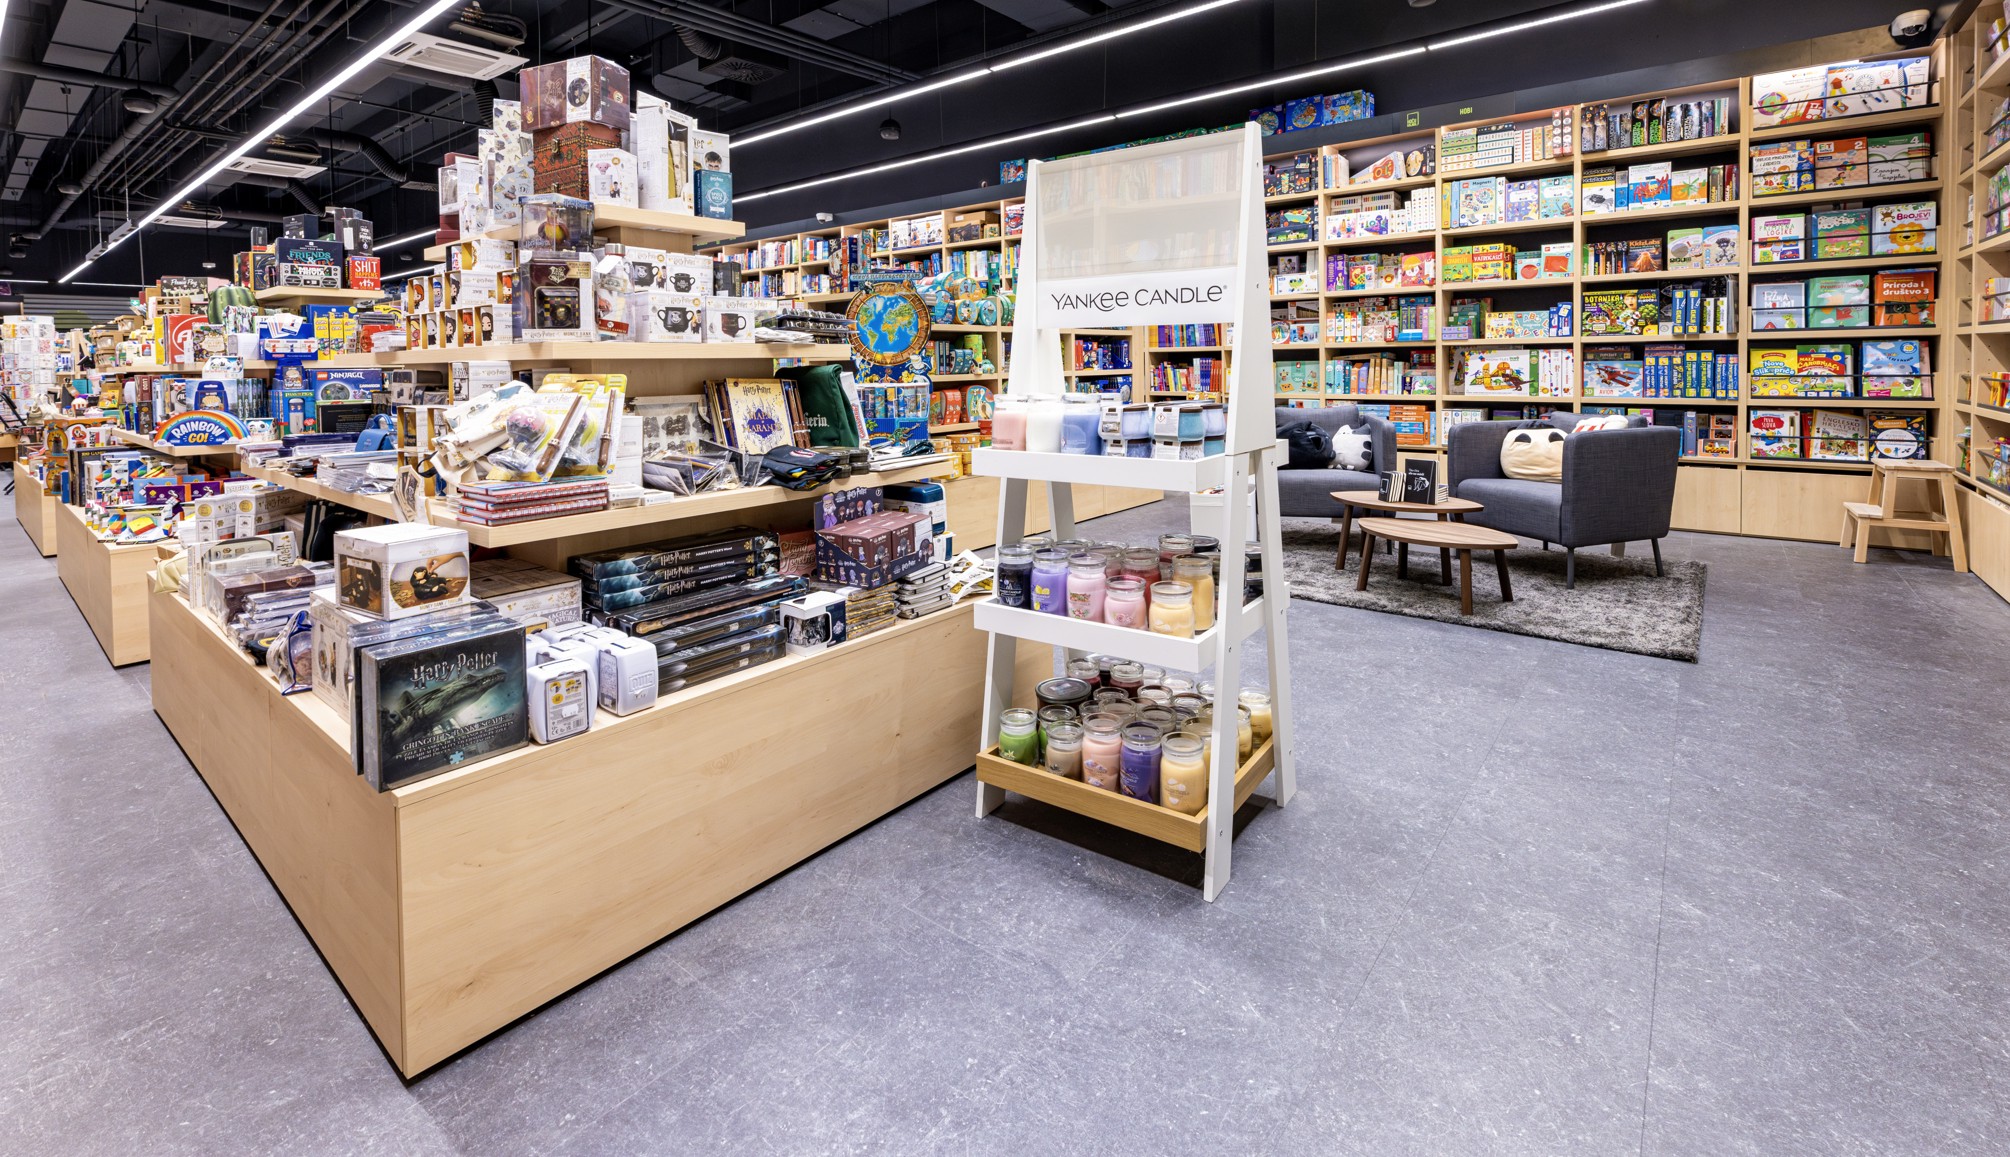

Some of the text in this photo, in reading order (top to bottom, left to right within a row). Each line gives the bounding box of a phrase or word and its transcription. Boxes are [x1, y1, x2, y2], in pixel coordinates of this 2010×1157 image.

[1460, 107, 1472, 115] HOBI
[1910, 136, 1920, 144] 4
[289, 249, 332, 260] FRIENDS
[355, 261, 378, 272] SHIT
[1883, 287, 1921, 296] društvo
[1051, 284, 1223, 312] YANKEE CANDLE
[1585, 295, 1621, 303] BOTANIKA
[743, 385, 772, 396] Harry Potter
[171, 421, 226, 437] RAINBOW
[188, 433, 209, 443] GO!
[410, 652, 498, 690] Harry Potter
[402, 732, 451, 751] GRINGOTTS
